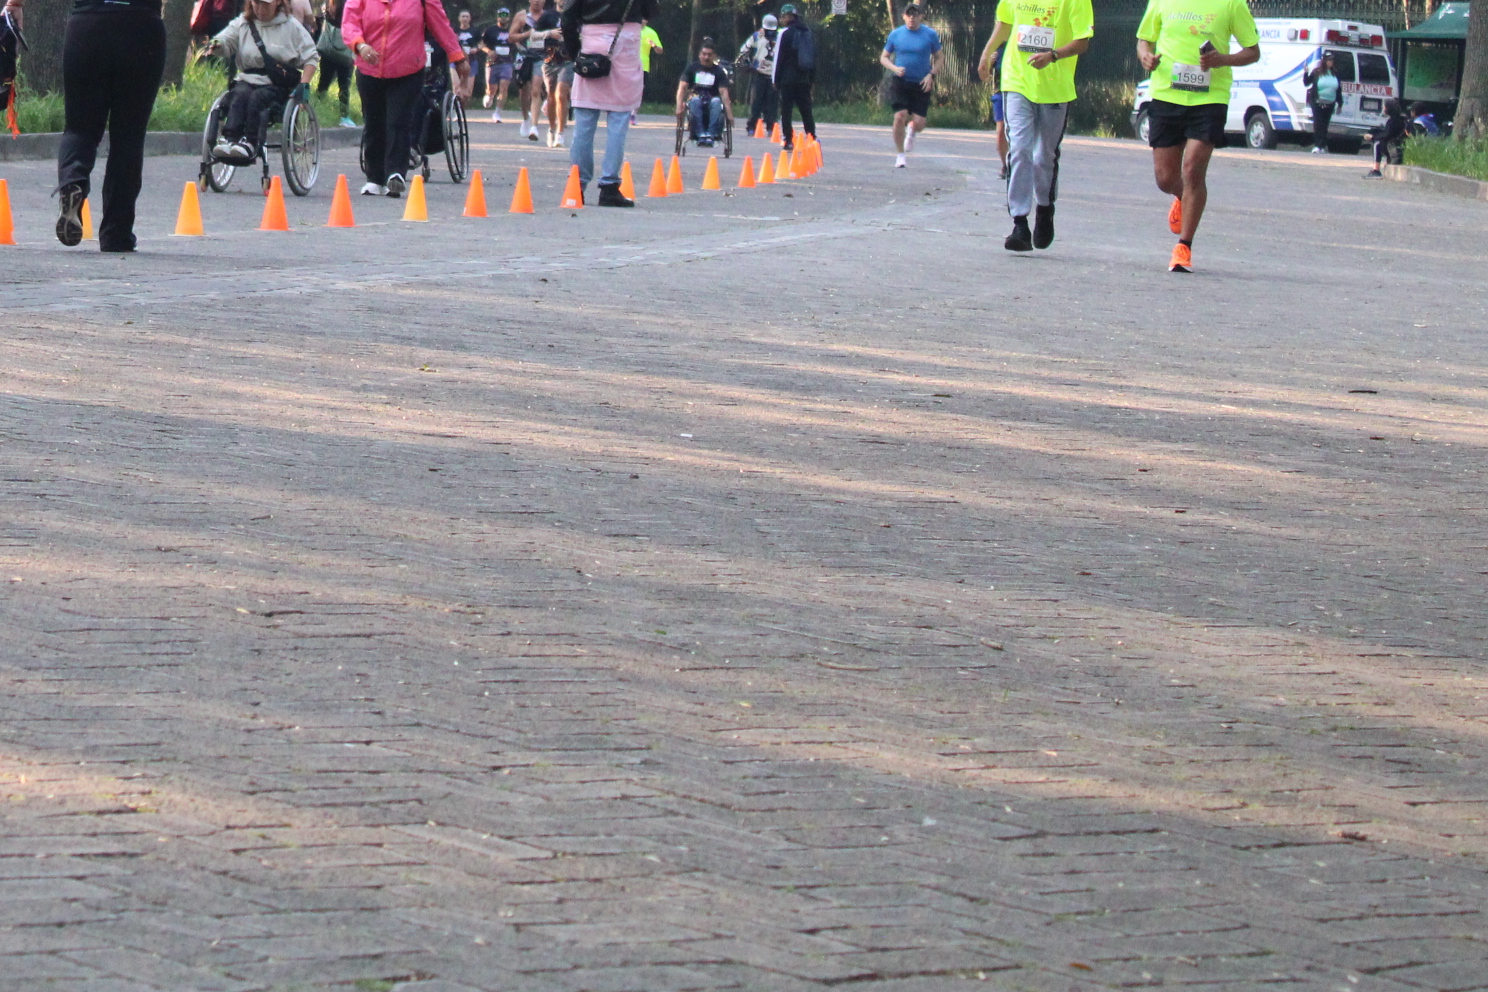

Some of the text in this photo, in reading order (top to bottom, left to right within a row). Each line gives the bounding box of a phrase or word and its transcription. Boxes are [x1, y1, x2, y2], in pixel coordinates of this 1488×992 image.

[1016, 3, 1046, 14] Achilles
[1166, 11, 1203, 22] Achilles
[1020, 34, 1048, 46] 2160
[1177, 72, 1205, 85] 1599
